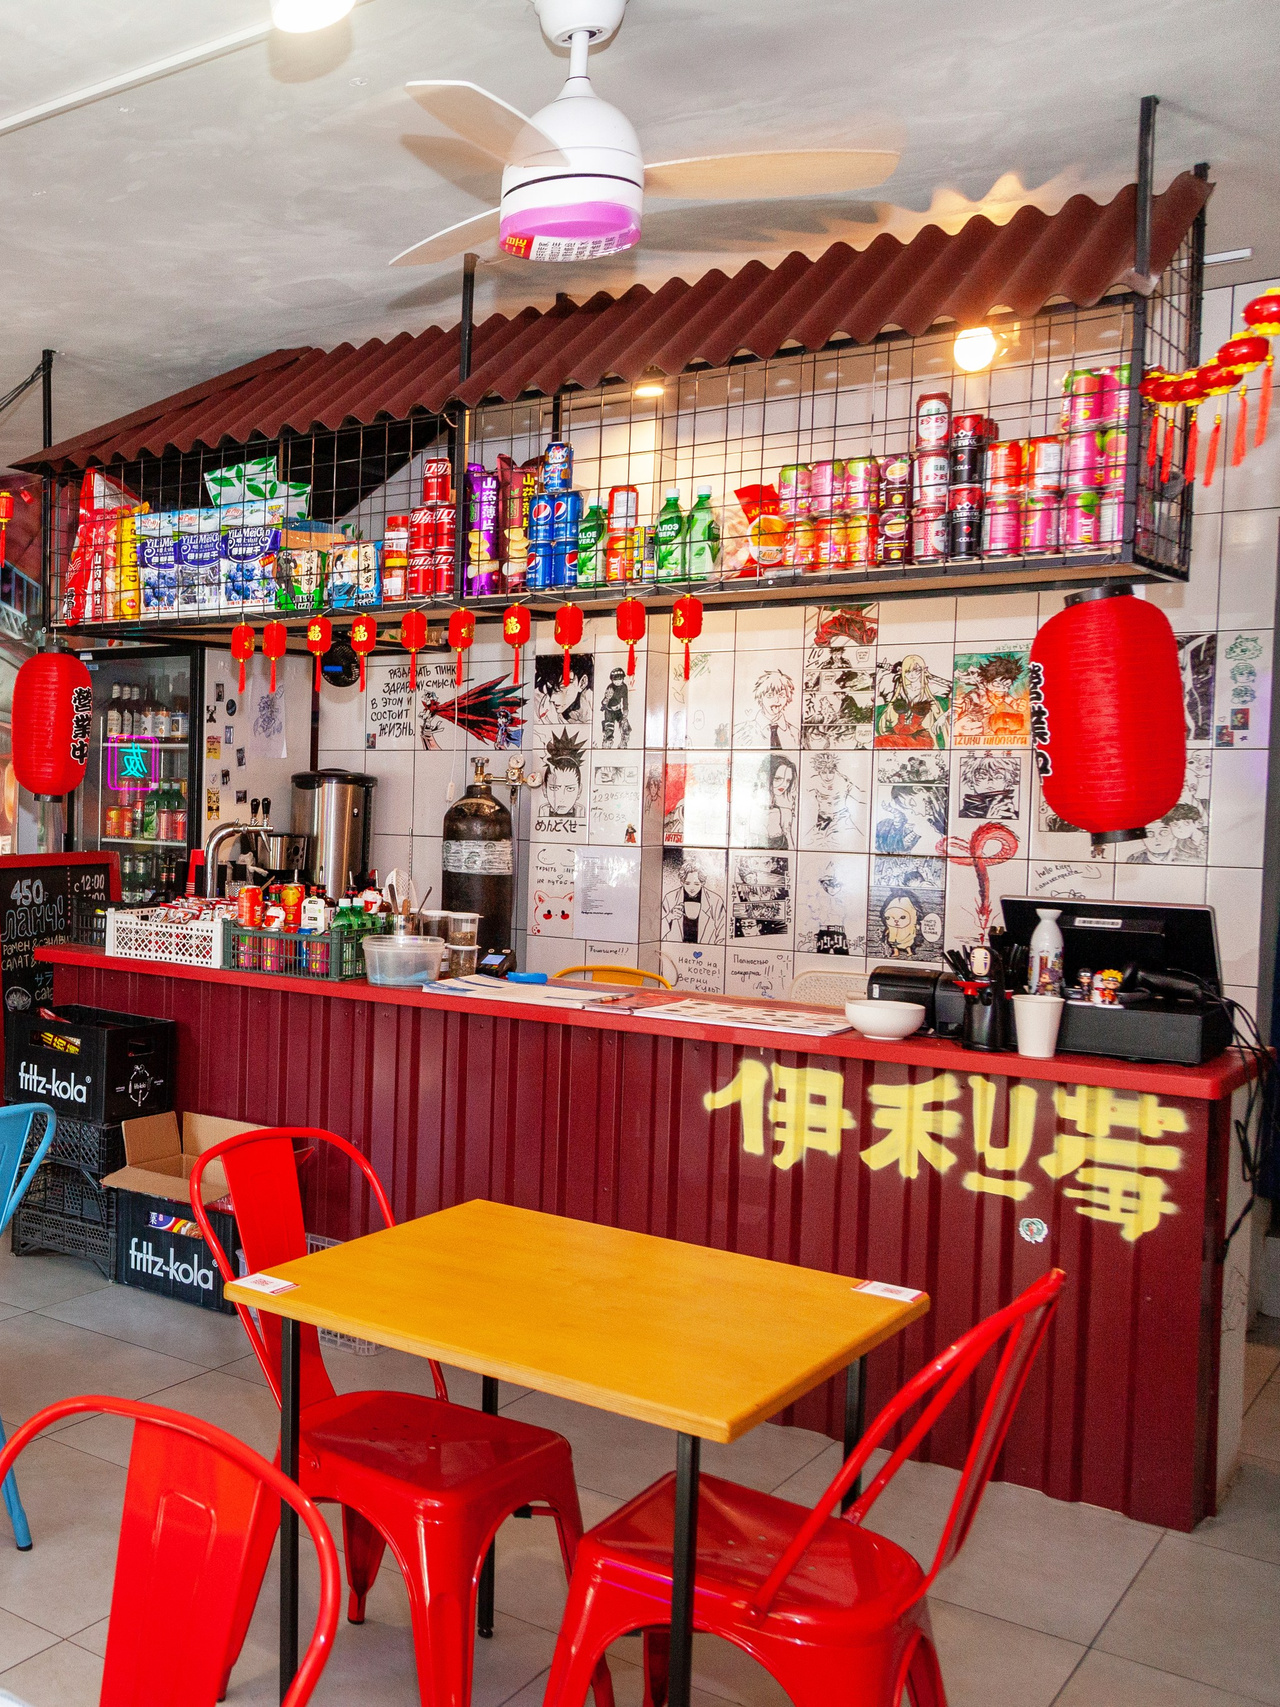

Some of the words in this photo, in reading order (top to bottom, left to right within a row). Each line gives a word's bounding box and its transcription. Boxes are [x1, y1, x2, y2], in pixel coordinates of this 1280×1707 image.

[482, 476, 498, 534] 山药薄片
[748, 503, 780, 519] МАНГ
[307, 624, 322, 642] 福
[353, 624, 368, 642] 福
[504, 616, 521, 635] 福
[388, 665, 432, 680] РАЗДААТЬ
[382, 696, 404, 708] ЭТОМ
[371, 708, 411, 722] СОСТОИТ
[535, 819, 587, 834] めんどくせー
[81, 873, 105, 891] 12:00
[19, 1061, 87, 1104] fritz-kola
[129, 1237, 214, 1291] fritz-kola
